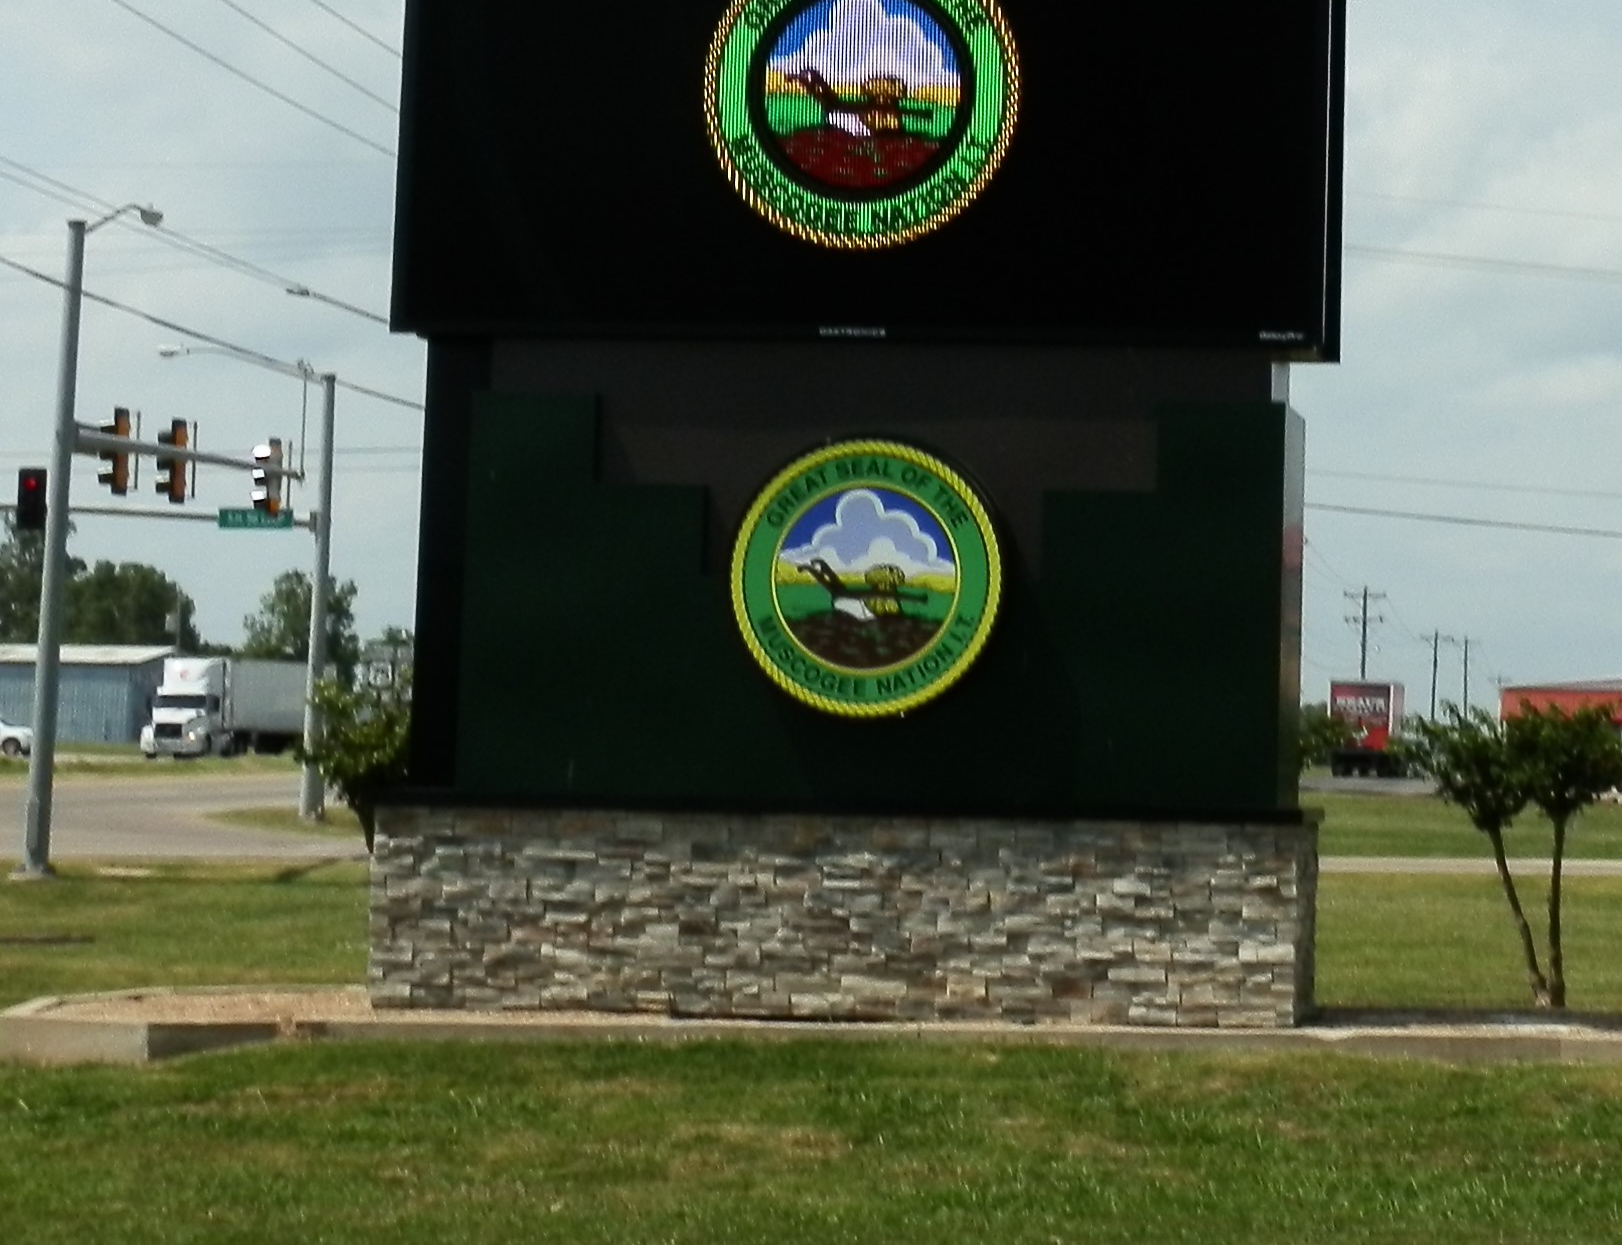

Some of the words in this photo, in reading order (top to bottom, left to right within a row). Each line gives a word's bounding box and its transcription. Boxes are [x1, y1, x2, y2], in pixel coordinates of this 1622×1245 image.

[730, 132, 859, 234] MUSCOGEE
[869, 173, 969, 232] NATION
[767, 468, 830, 528] GREAT
[835, 458, 894, 479] SEAL
[900, 465, 931, 490] OF
[936, 484, 969, 529] THE
[757, 615, 869, 696] MUSCOGEE
[875, 647, 955, 696] NATION
